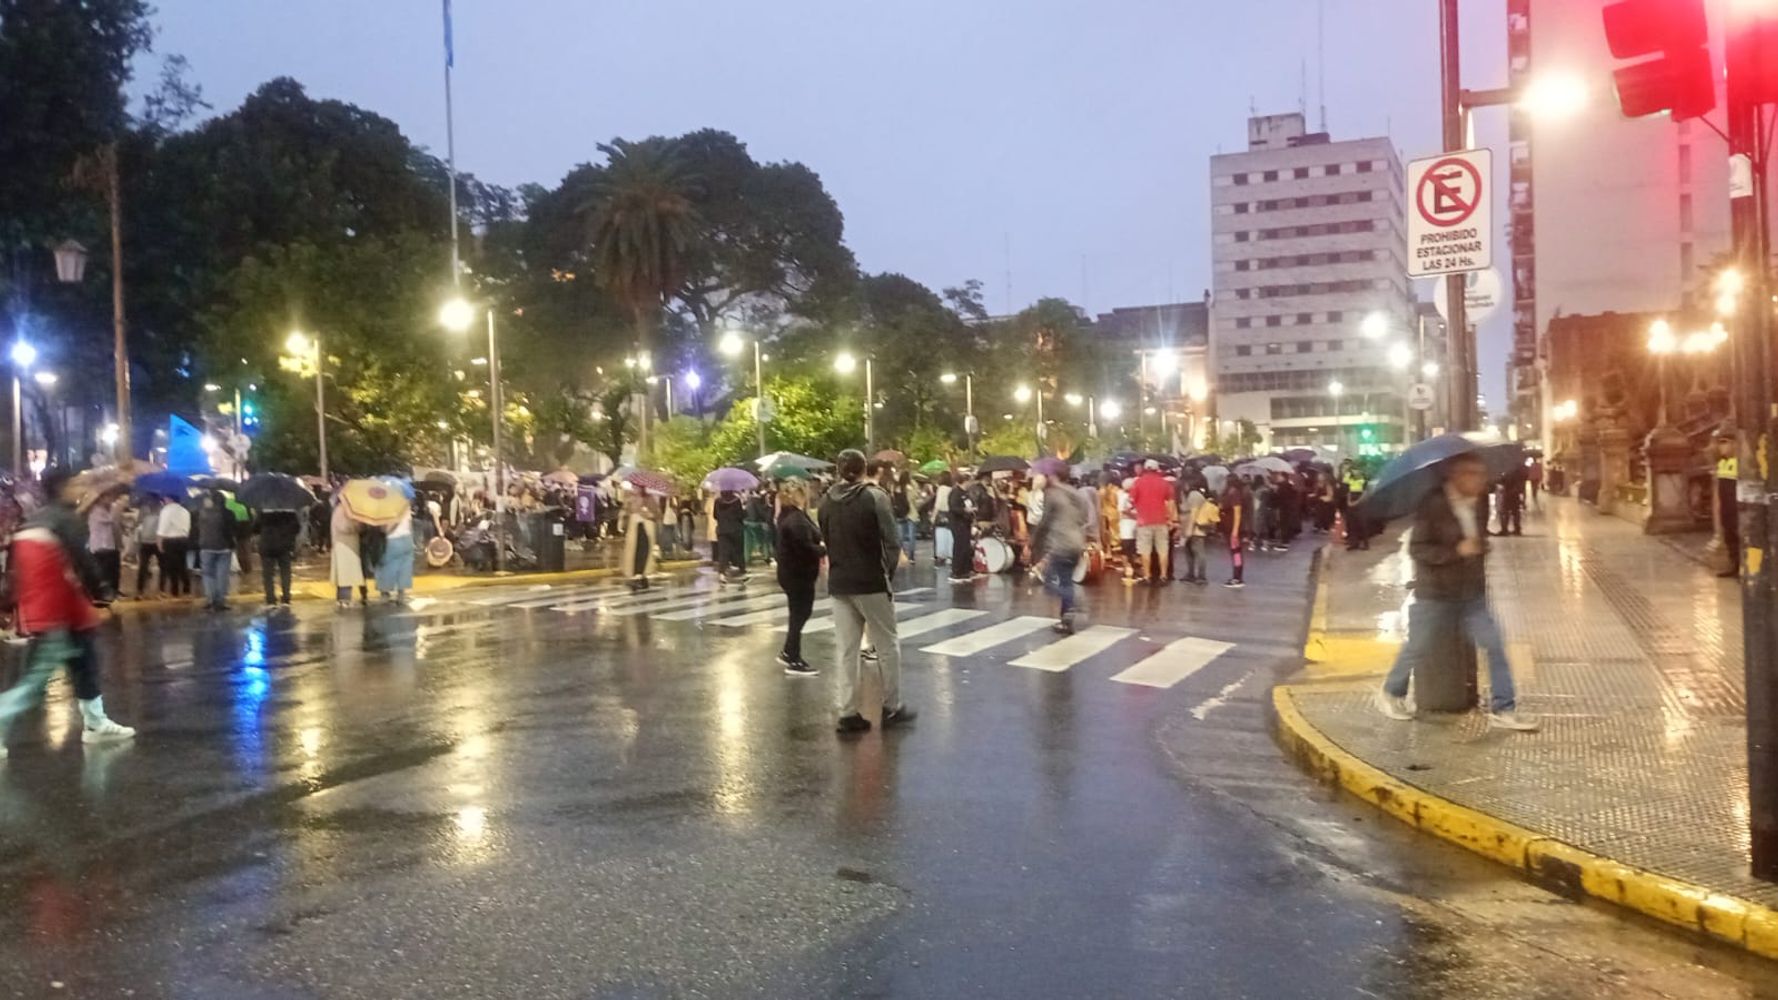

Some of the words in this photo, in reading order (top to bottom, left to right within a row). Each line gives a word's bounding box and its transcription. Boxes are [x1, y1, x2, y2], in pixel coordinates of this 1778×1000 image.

[1434, 171, 1463, 214] E
[1420, 228, 1477, 244] PROHIBIDO
[1416, 241, 1482, 258] ESTACIONAR
[1423, 258, 1442, 271] LAS
[1444, 257, 1456, 269] 24
